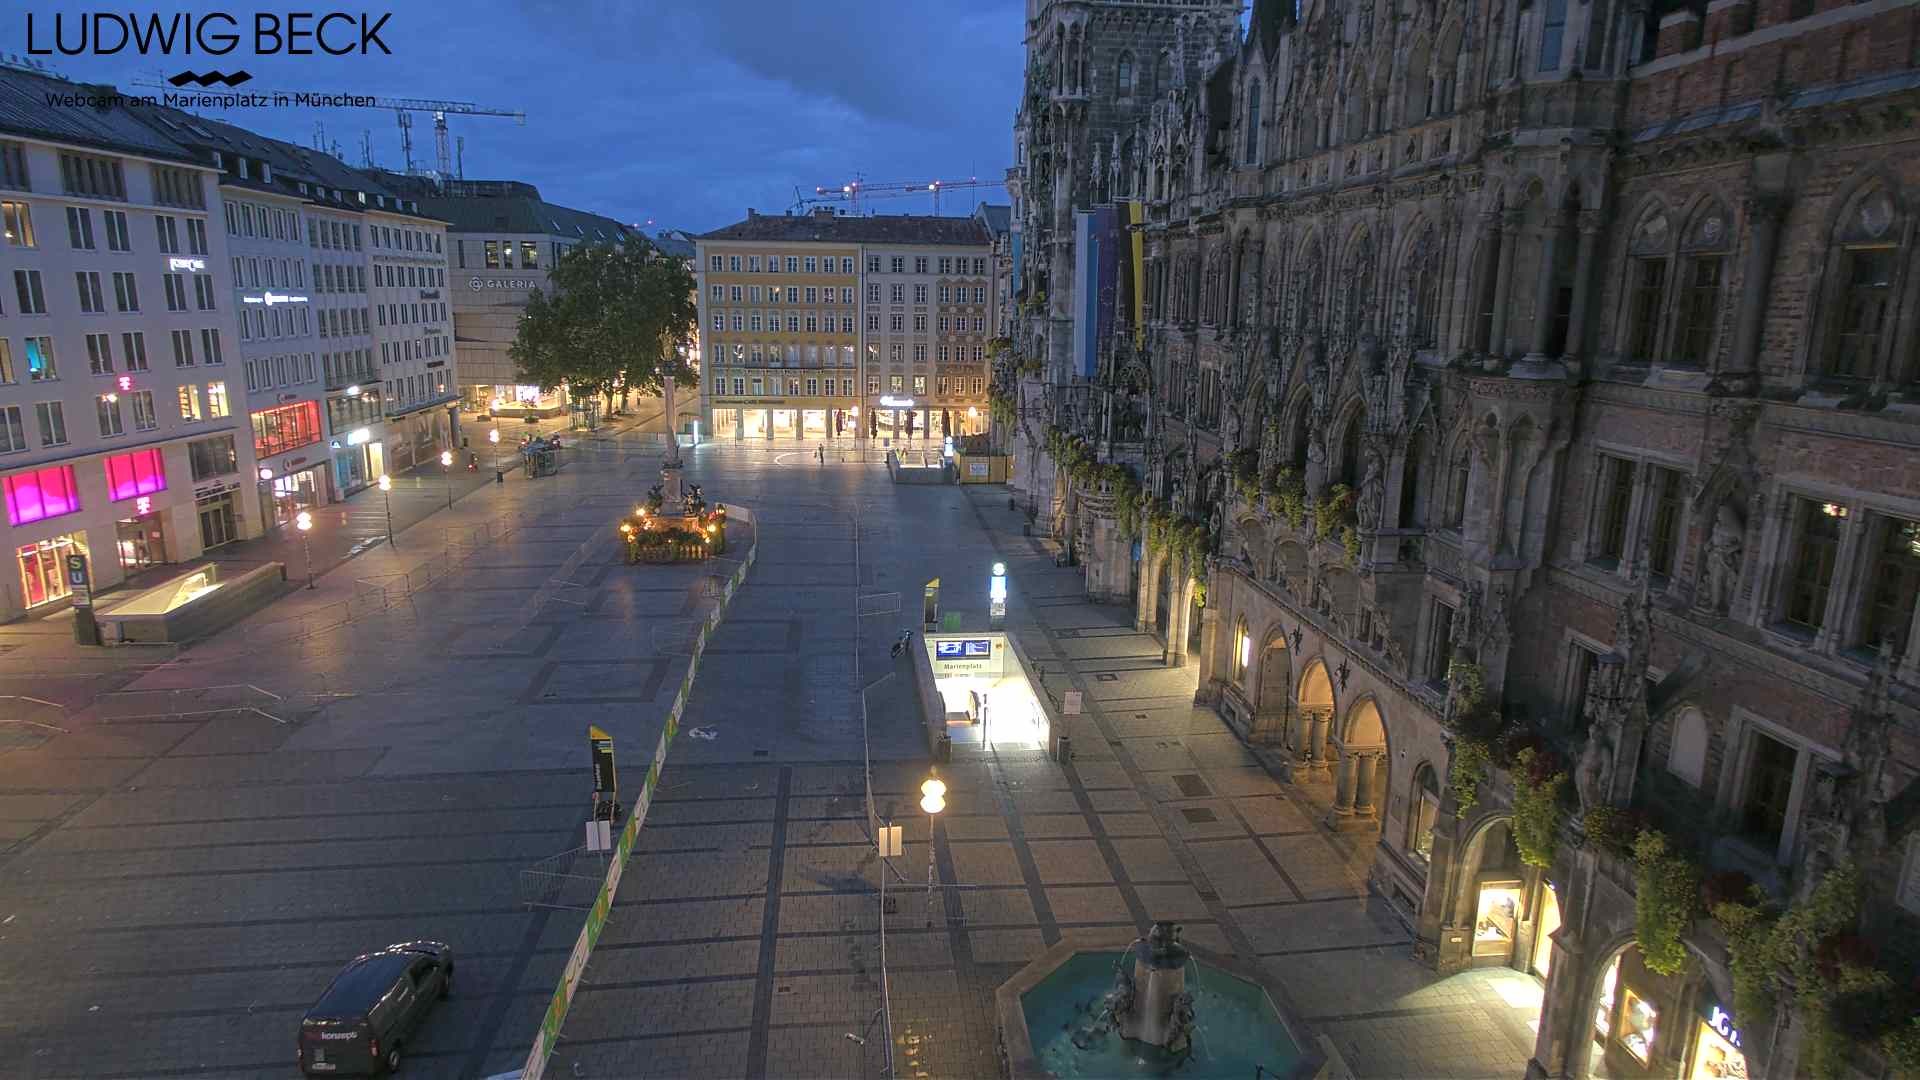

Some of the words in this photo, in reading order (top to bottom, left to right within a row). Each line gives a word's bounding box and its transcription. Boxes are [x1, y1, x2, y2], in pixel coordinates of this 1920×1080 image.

[487, 280, 536, 289] GALERIA
[70, 557, 81, 569] S
[72, 571, 83, 584] U
